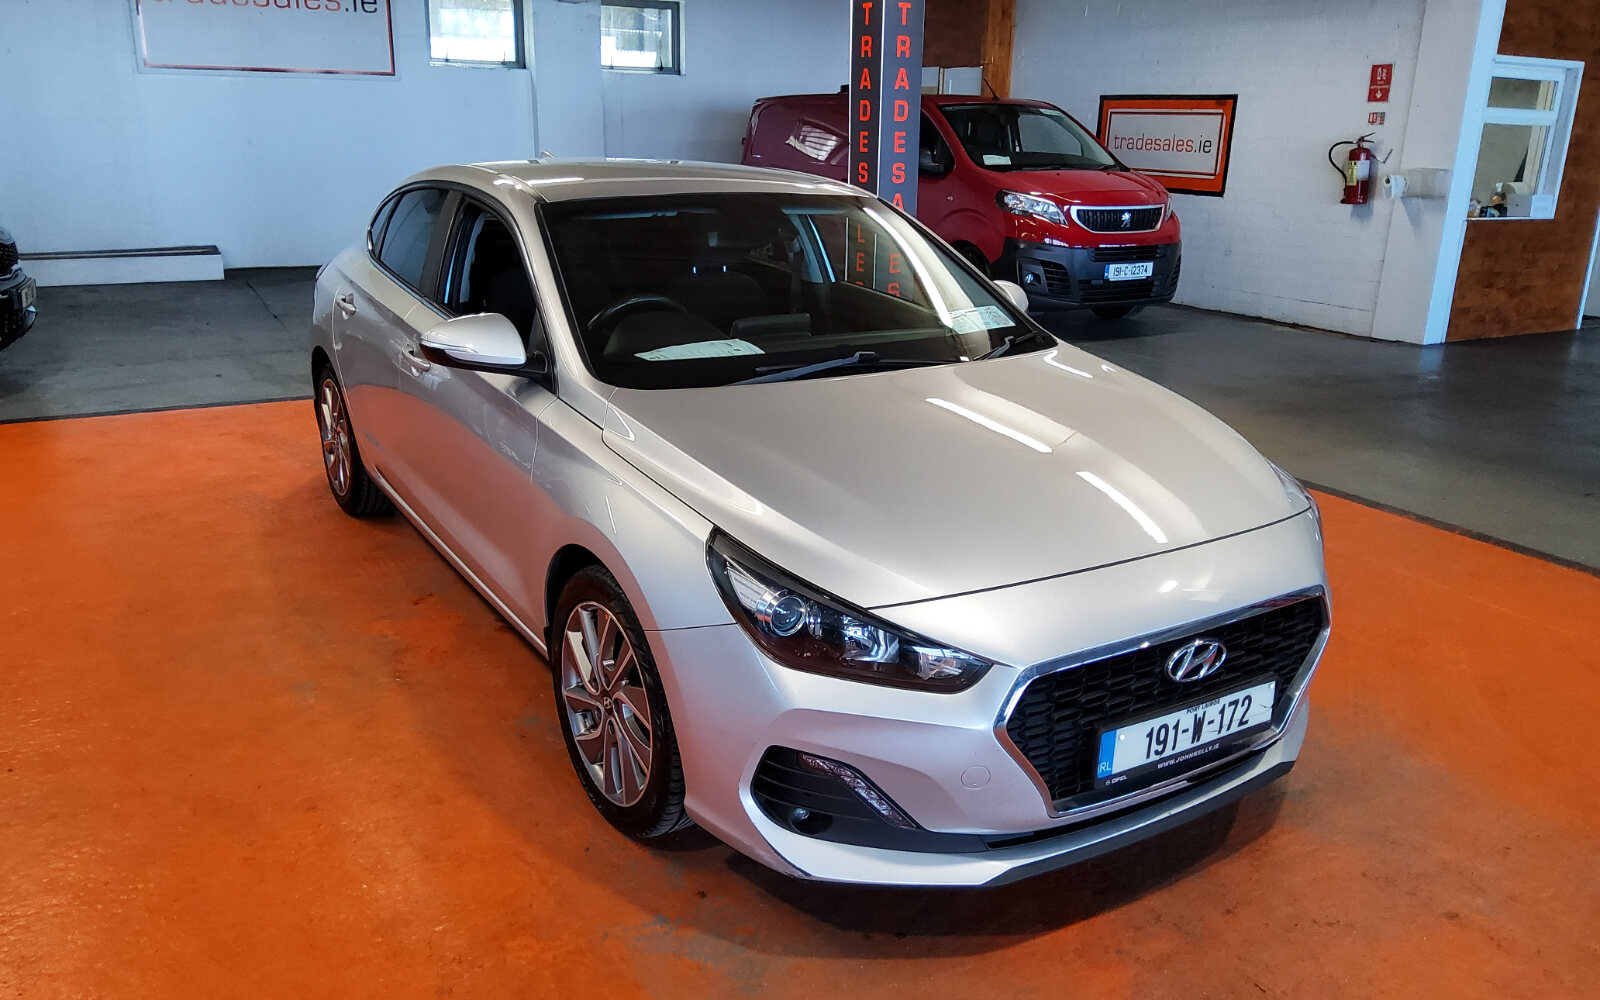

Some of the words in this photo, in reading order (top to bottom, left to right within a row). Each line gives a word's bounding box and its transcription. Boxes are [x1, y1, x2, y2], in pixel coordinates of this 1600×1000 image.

[1114, 133, 1212, 154] tradesales.ie
[1113, 264, 1148, 277] 191-C-12374
[1145, 694, 1253, 759] 191-W-172
[1157, 743, 1220, 770] WWW.JOHNKELLY.IE
[1111, 775, 1128, 784] OPEL
